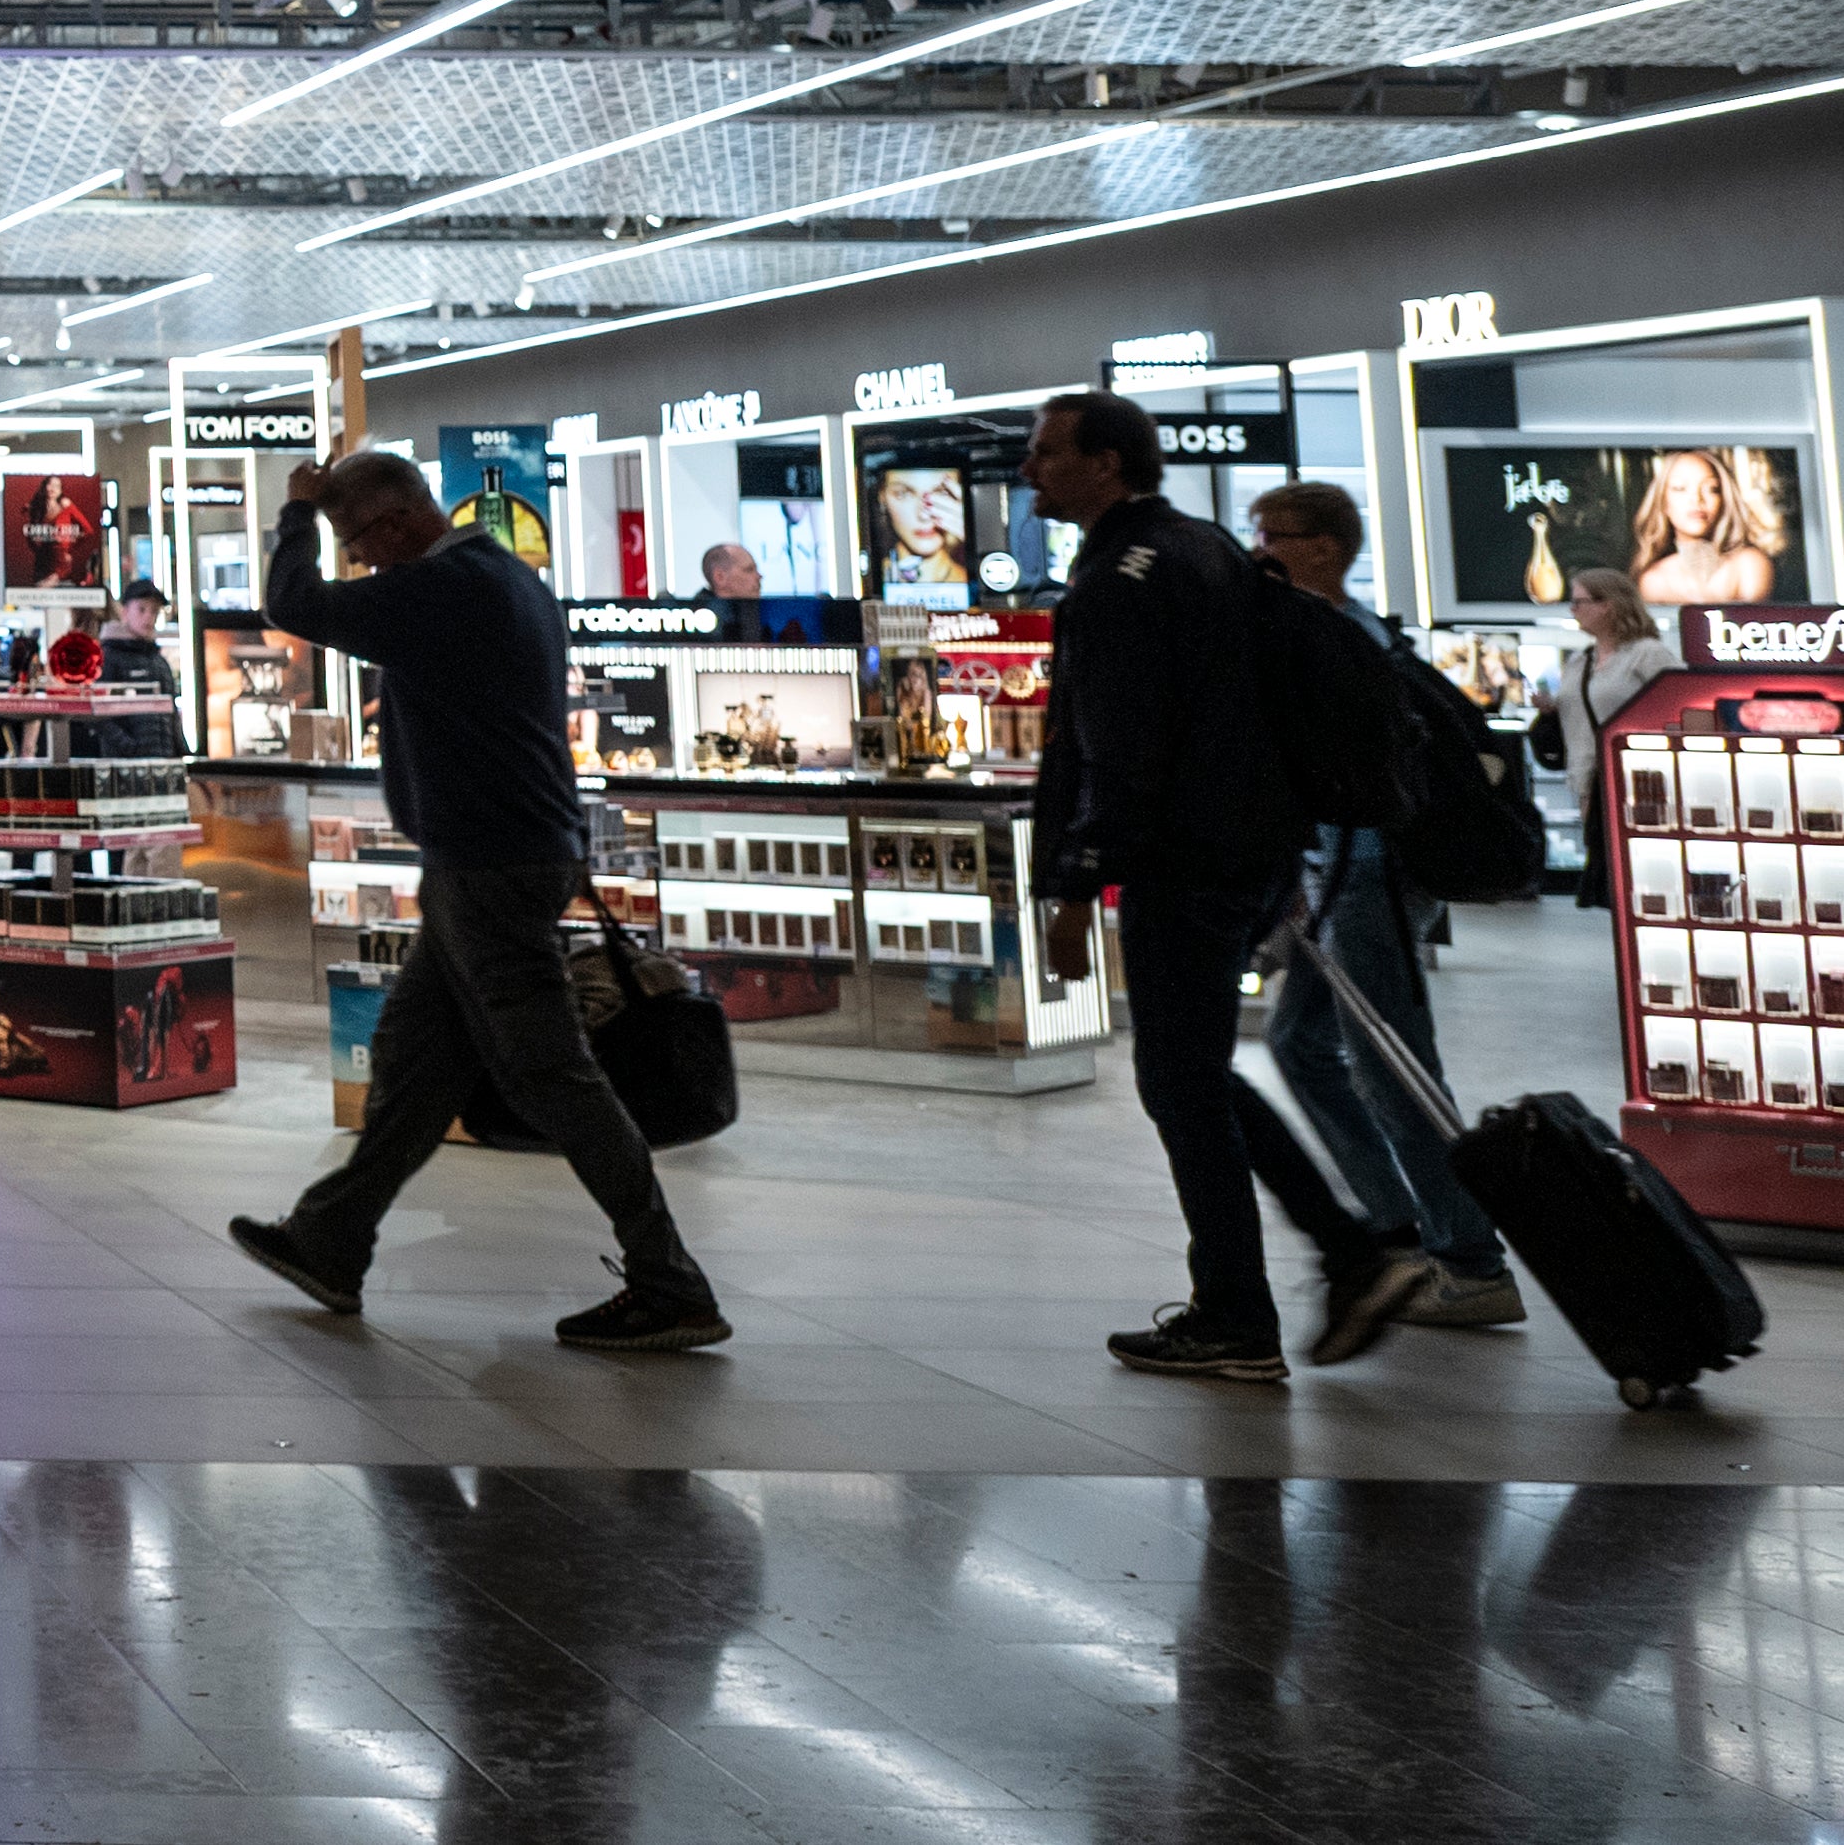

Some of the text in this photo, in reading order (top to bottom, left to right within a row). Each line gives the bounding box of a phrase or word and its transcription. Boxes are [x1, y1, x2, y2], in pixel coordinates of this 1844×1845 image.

[1400, 290, 1500, 346] DIOR
[855, 362, 955, 412] CHANEL
[185, 415, 316, 441] TOM FORD
[472, 430, 510, 445] BOSS
[1157, 424, 1247, 453] BOSS
[568, 603, 718, 633] rabanne
